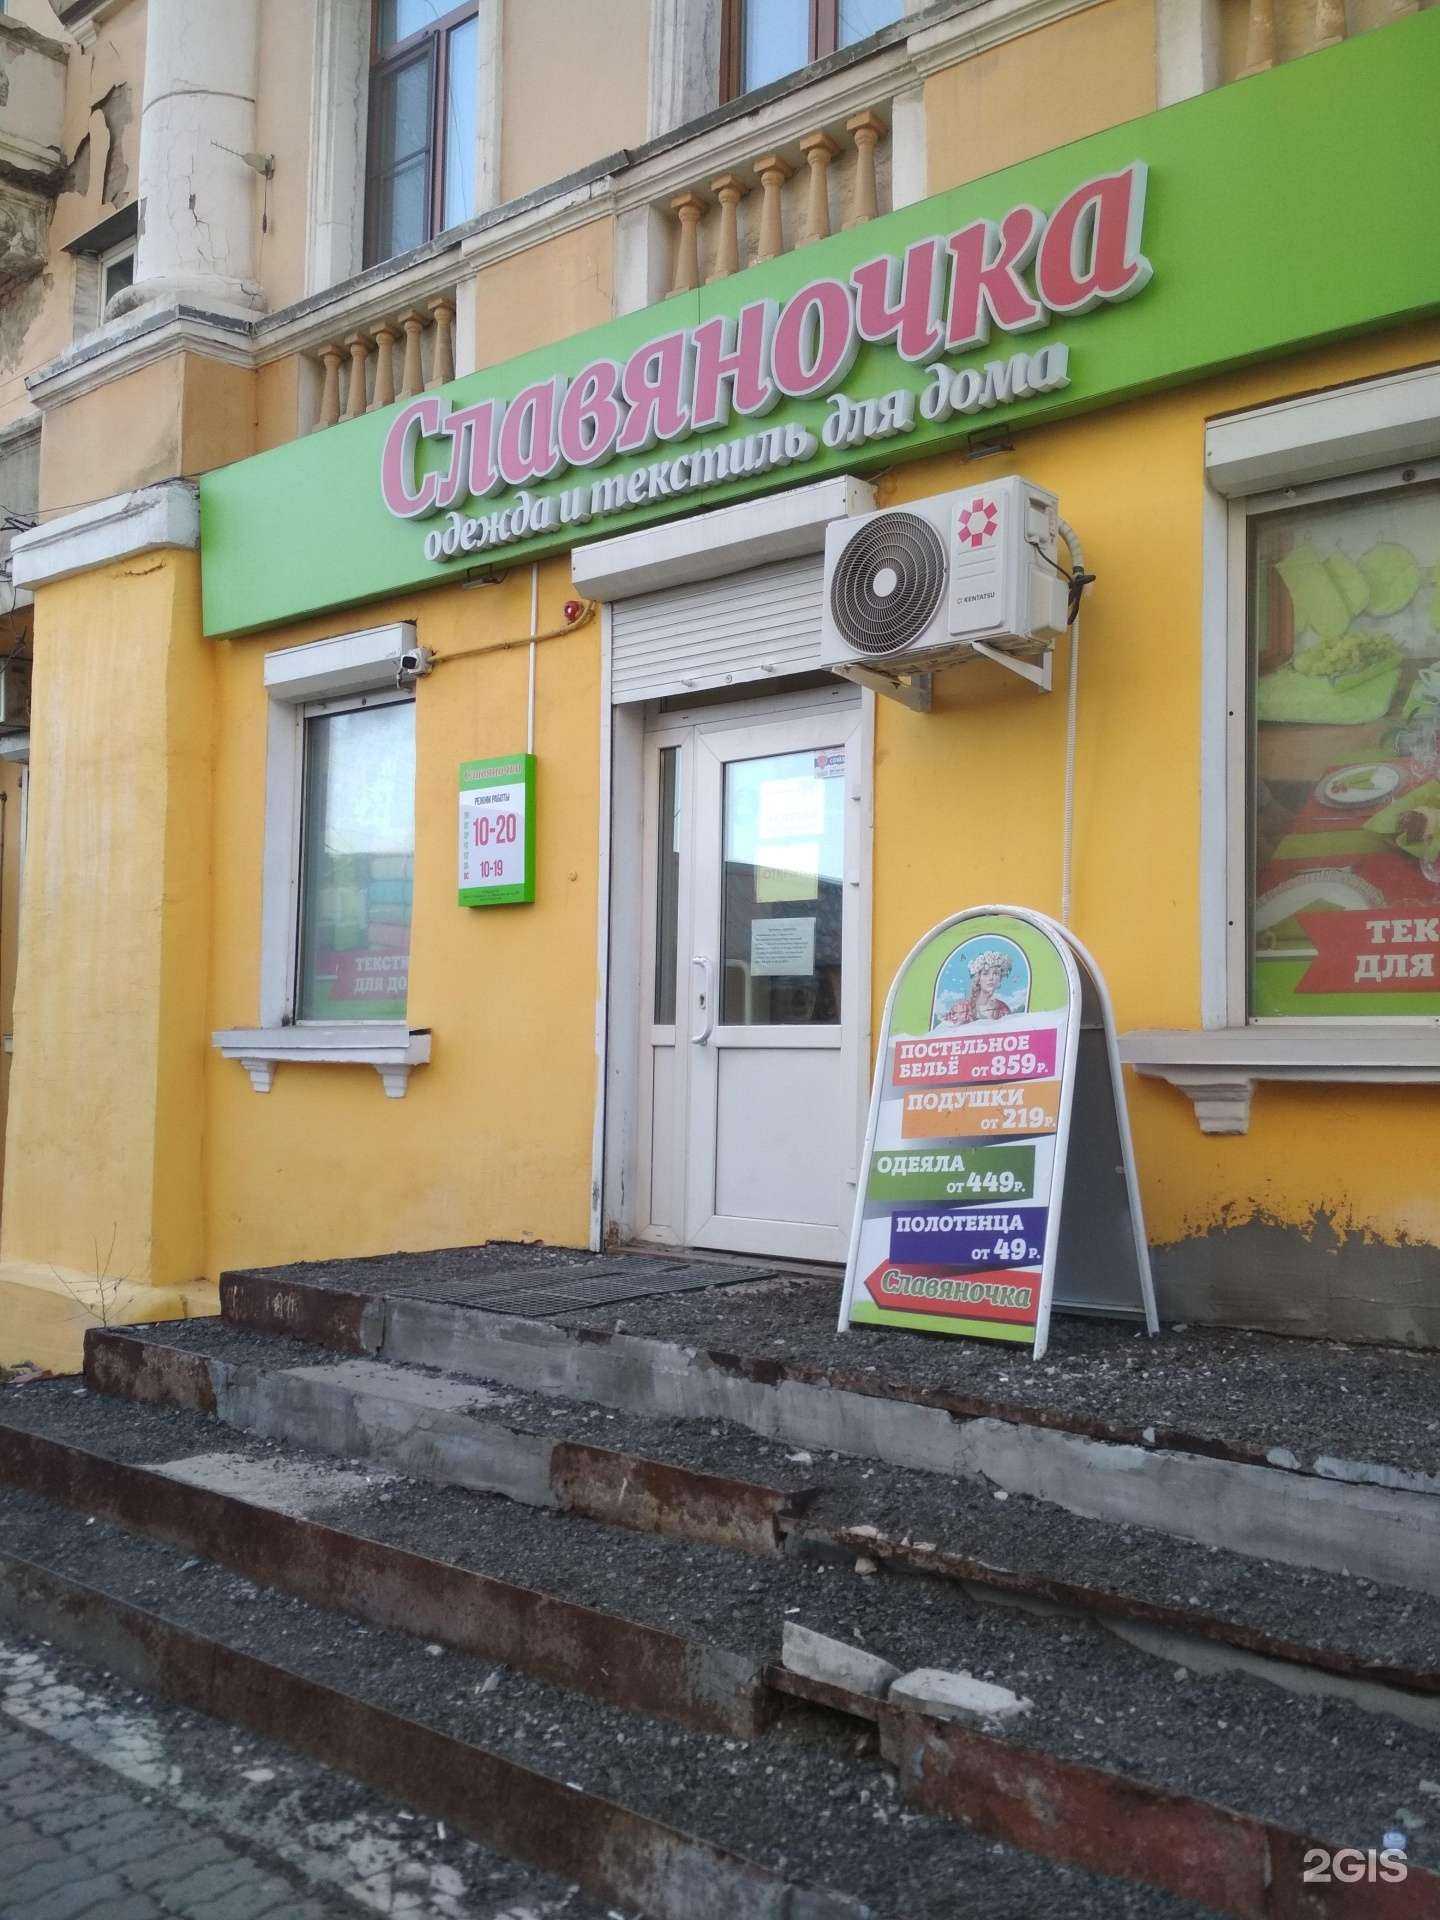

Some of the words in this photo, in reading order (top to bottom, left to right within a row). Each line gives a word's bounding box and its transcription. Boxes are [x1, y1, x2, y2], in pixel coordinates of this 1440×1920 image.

[382, 160, 1153, 520] Славяночка
[424, 490, 560, 562] одежда
[559, 486, 592, 525] и
[590, 422, 818, 518] текстиль
[822, 388, 916, 451] для
[919, 341, 1072, 423] дома
[473, 813, 517, 847] 10-20
[480, 859, 503, 878] 10-19
[1354, 953, 1435, 984] ДЛЯ
[900, 1035, 1030, 1059] ПОСТЕЛЬНОЕ
[899, 1056, 960, 1079] БЕЛЬЁ
[907, 1088, 1025, 1113] ПОДУШКИ
[877, 1155, 966, 1177] ОДЕЯЛА
[896, 1214, 1024, 1234] ПОЛОТЕНЦА
[881, 1268, 1033, 1310] Славяночка
